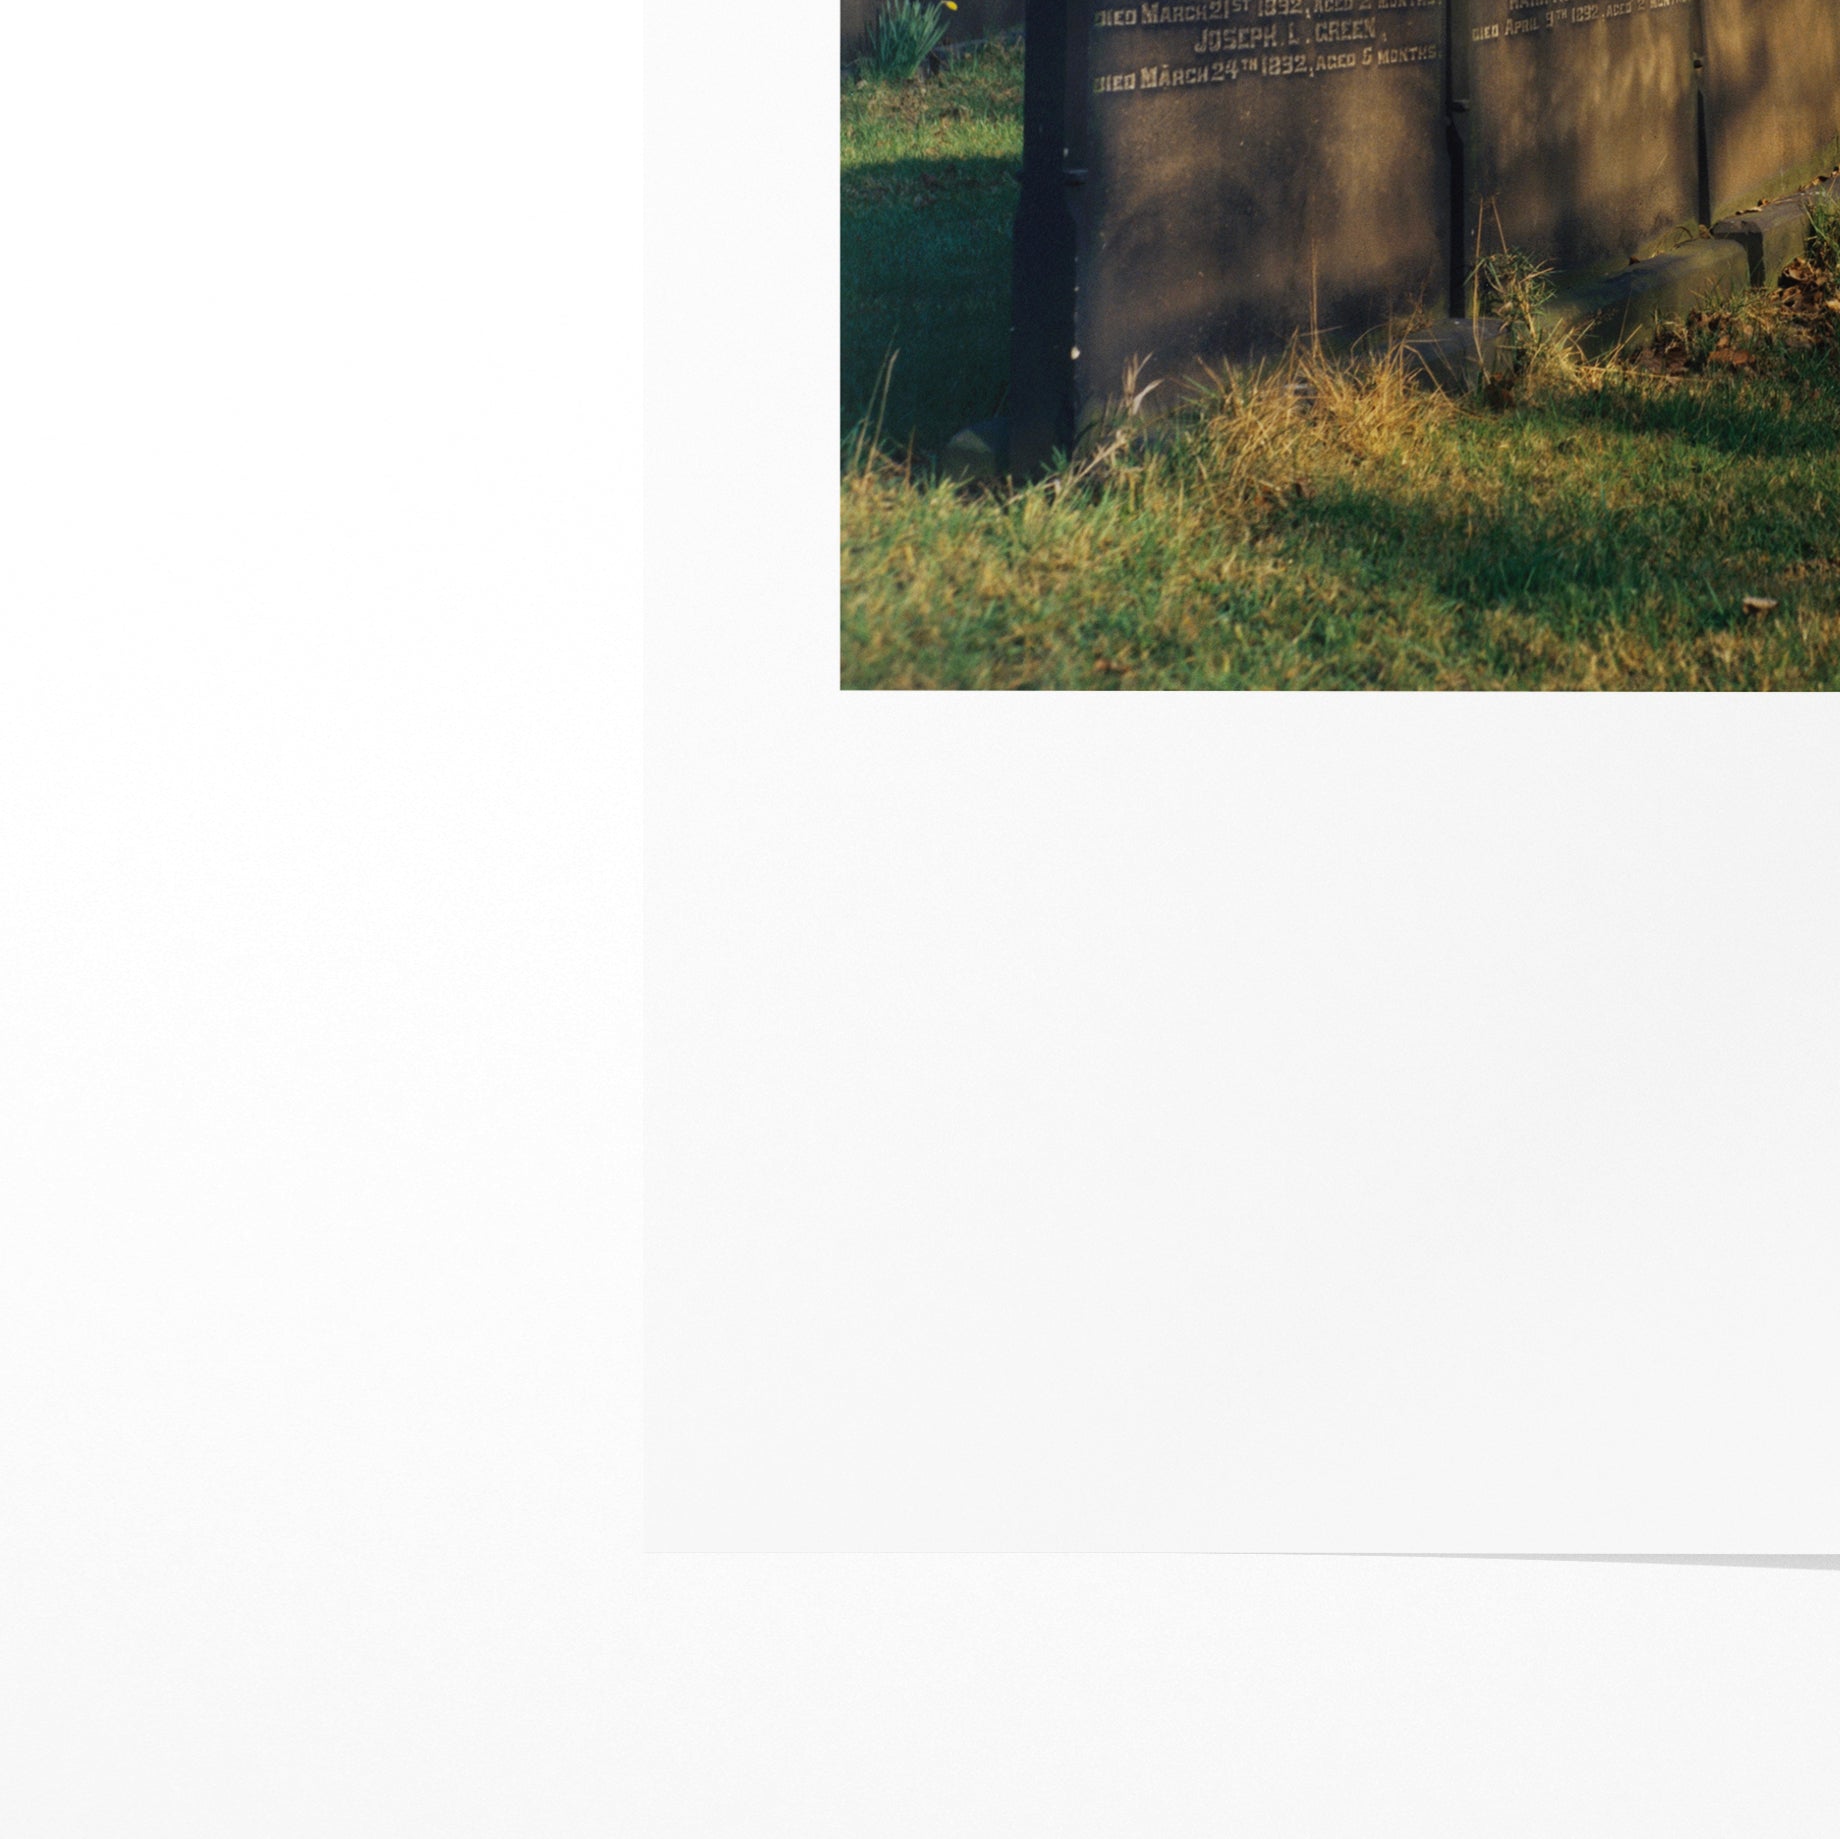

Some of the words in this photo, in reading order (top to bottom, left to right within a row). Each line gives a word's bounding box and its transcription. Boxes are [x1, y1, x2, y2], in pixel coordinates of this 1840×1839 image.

[1094, 7, 1138, 27] DIED
[1140, 2, 1208, 26] MARCH
[1471, 23, 1500, 42] DIED
[1504, 17, 1540, 37] APRIL
[1092, 73, 1137, 95] DIED
[1139, 64, 1209, 90] MARCH
[1315, 51, 1357, 72] AGED
